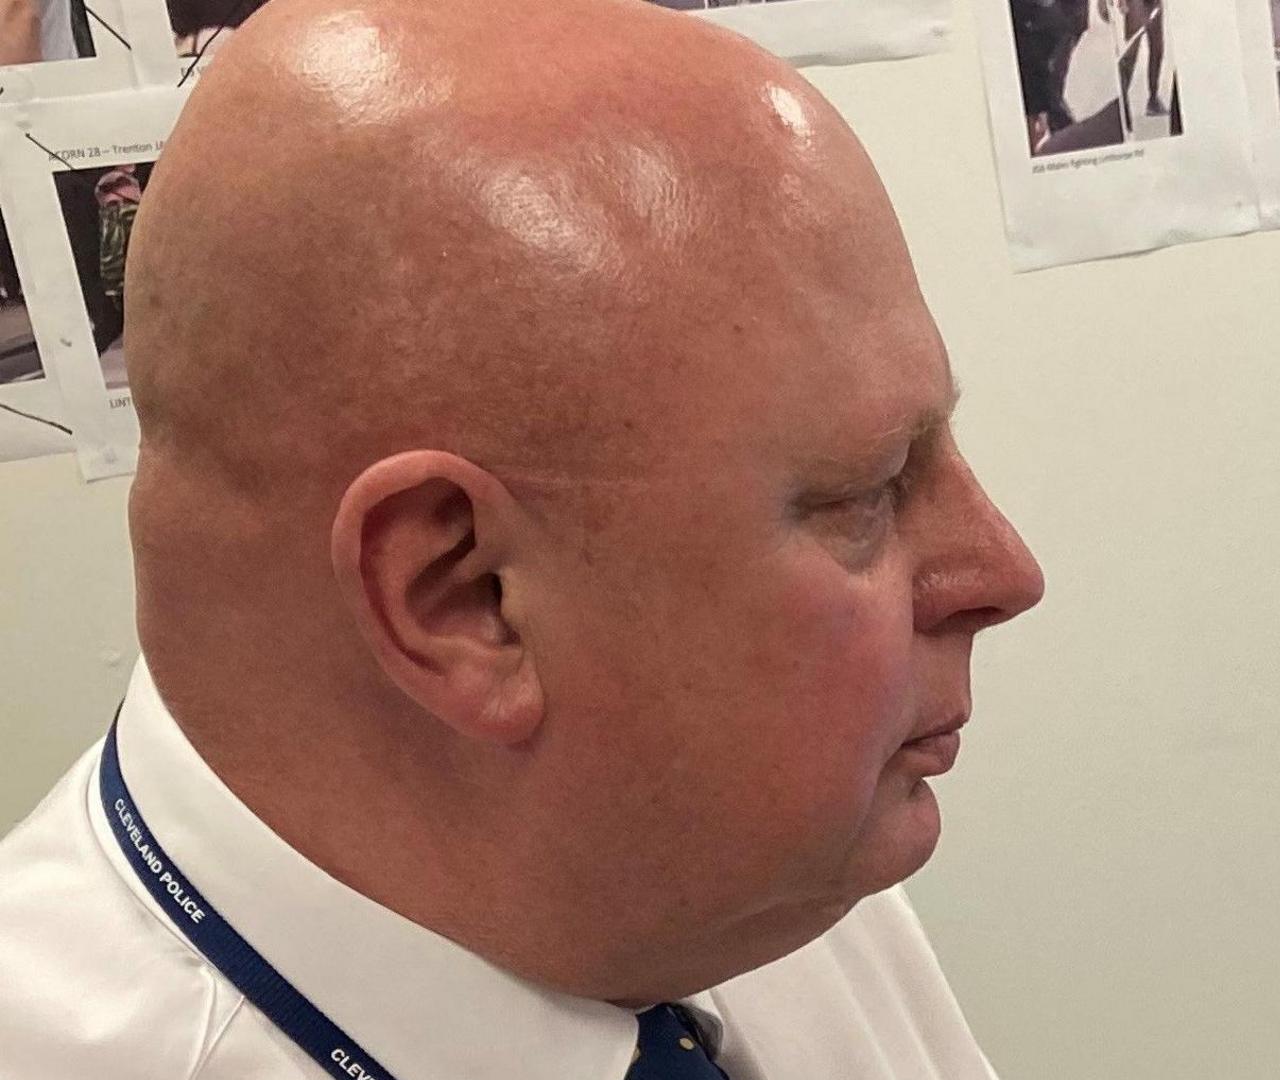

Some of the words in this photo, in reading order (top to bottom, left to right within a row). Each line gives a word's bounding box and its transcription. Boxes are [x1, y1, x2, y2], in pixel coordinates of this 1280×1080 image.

[88, 147, 100, 157] 28
[113, 141, 151, 154] Trenton
[115, 798, 162, 873] CLEVELAND
[159, 872, 205, 923] POLICE
